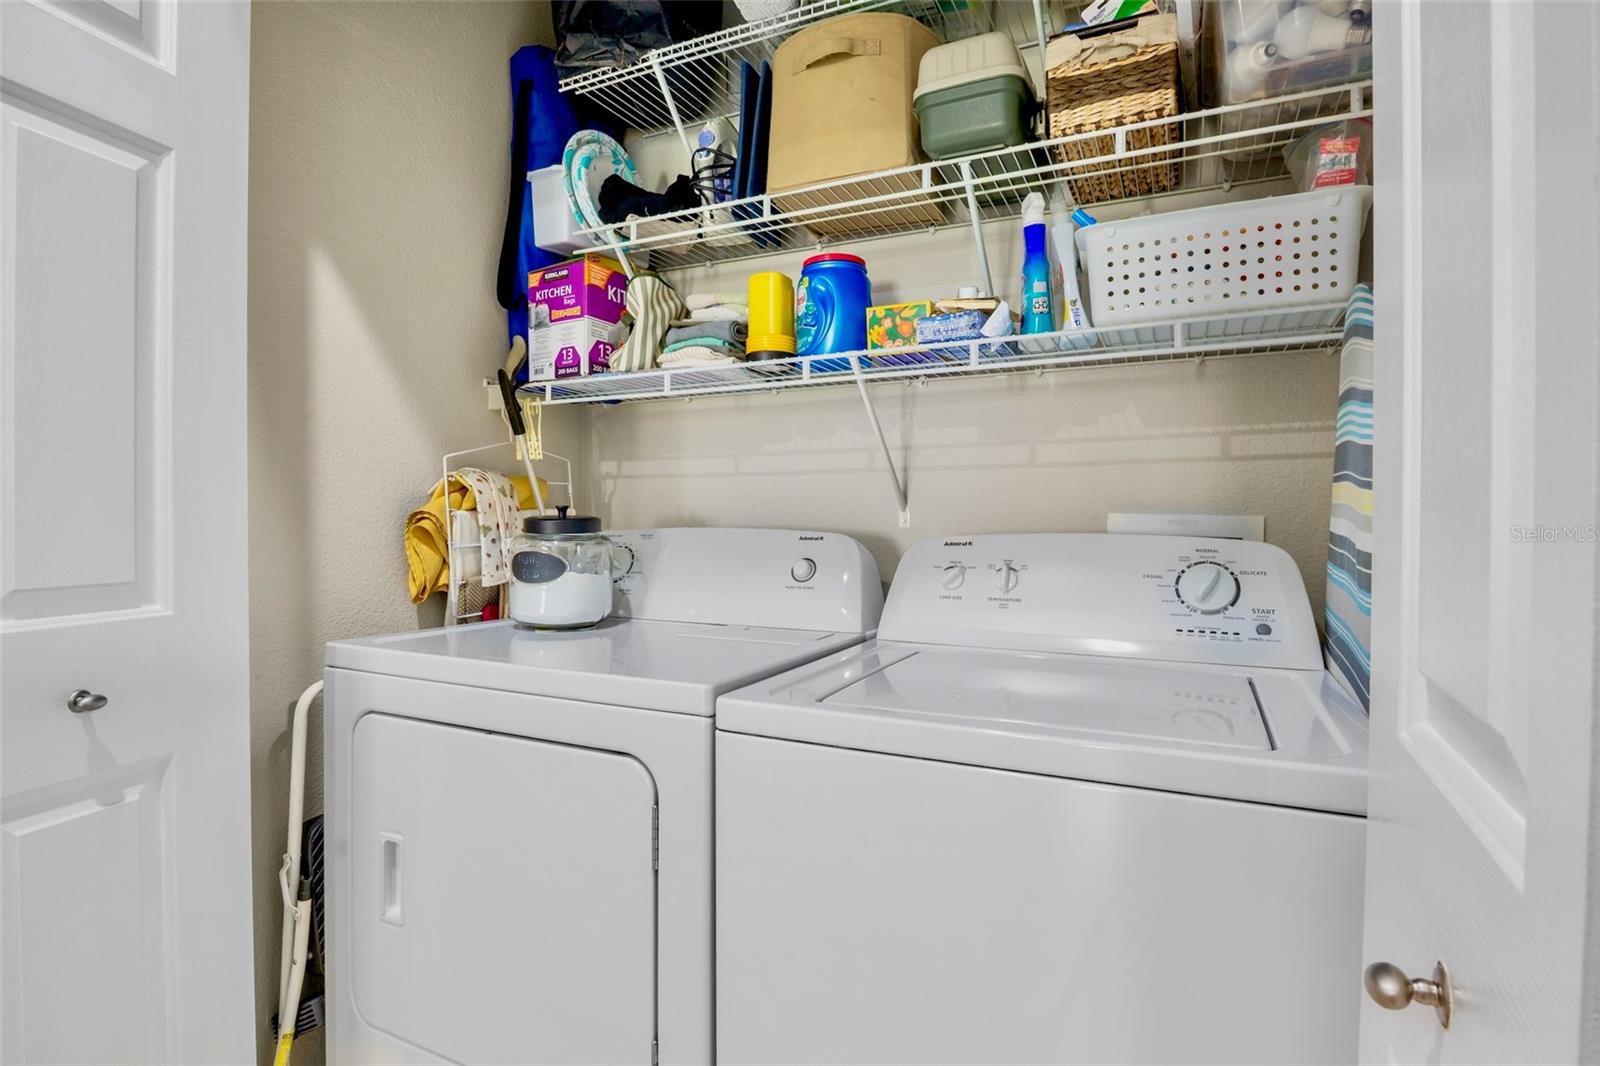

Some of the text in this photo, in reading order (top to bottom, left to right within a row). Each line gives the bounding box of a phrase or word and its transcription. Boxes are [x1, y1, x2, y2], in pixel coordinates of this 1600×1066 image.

[544, 269, 569, 279] KIRKLAND
[535, 285, 573, 301] KITCHEN
[561, 348, 574, 360] 13
[566, 366, 579, 374] BAGS
